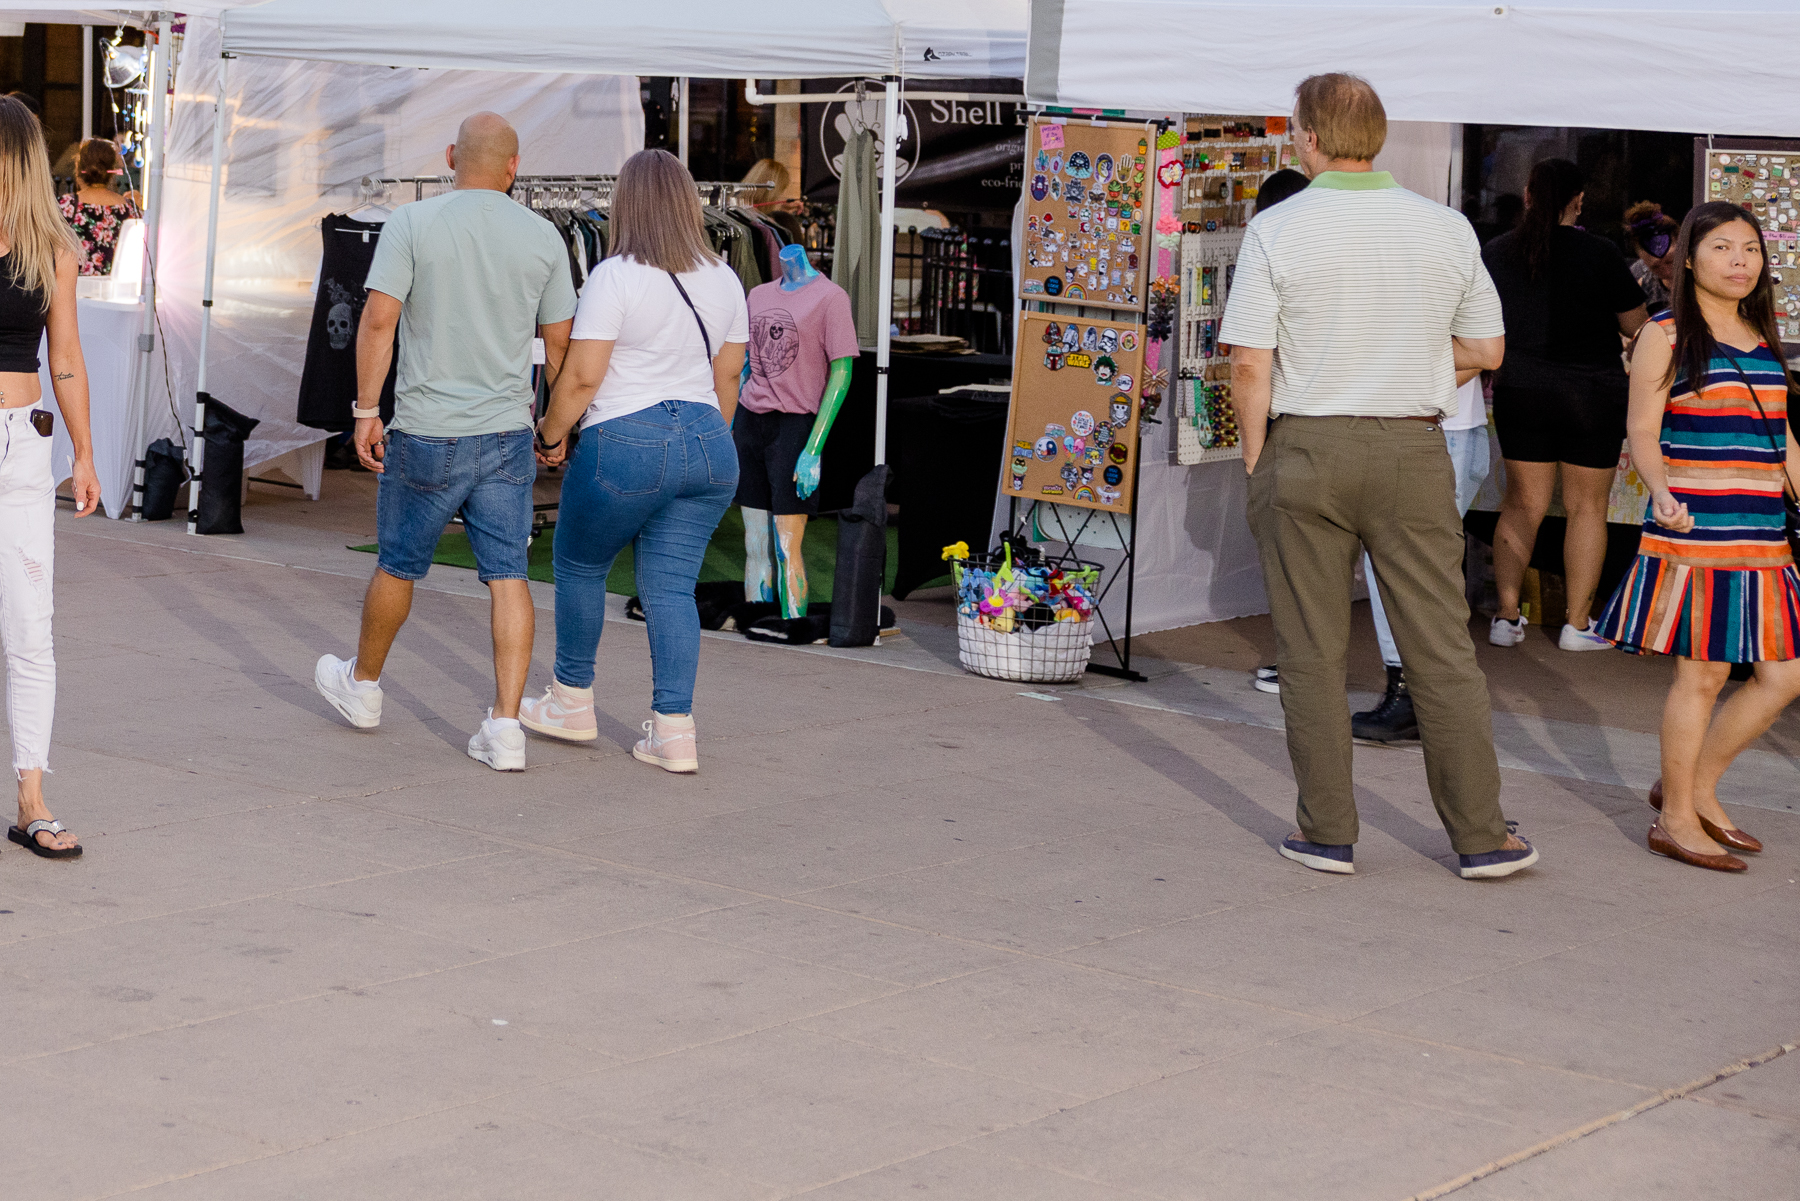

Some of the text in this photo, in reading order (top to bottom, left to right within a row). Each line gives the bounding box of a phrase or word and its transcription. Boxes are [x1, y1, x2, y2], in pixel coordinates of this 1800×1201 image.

[930, 99, 1003, 125] Shell
[1069, 353, 1091, 362] STAR
[1067, 359, 1091, 368] WARS
